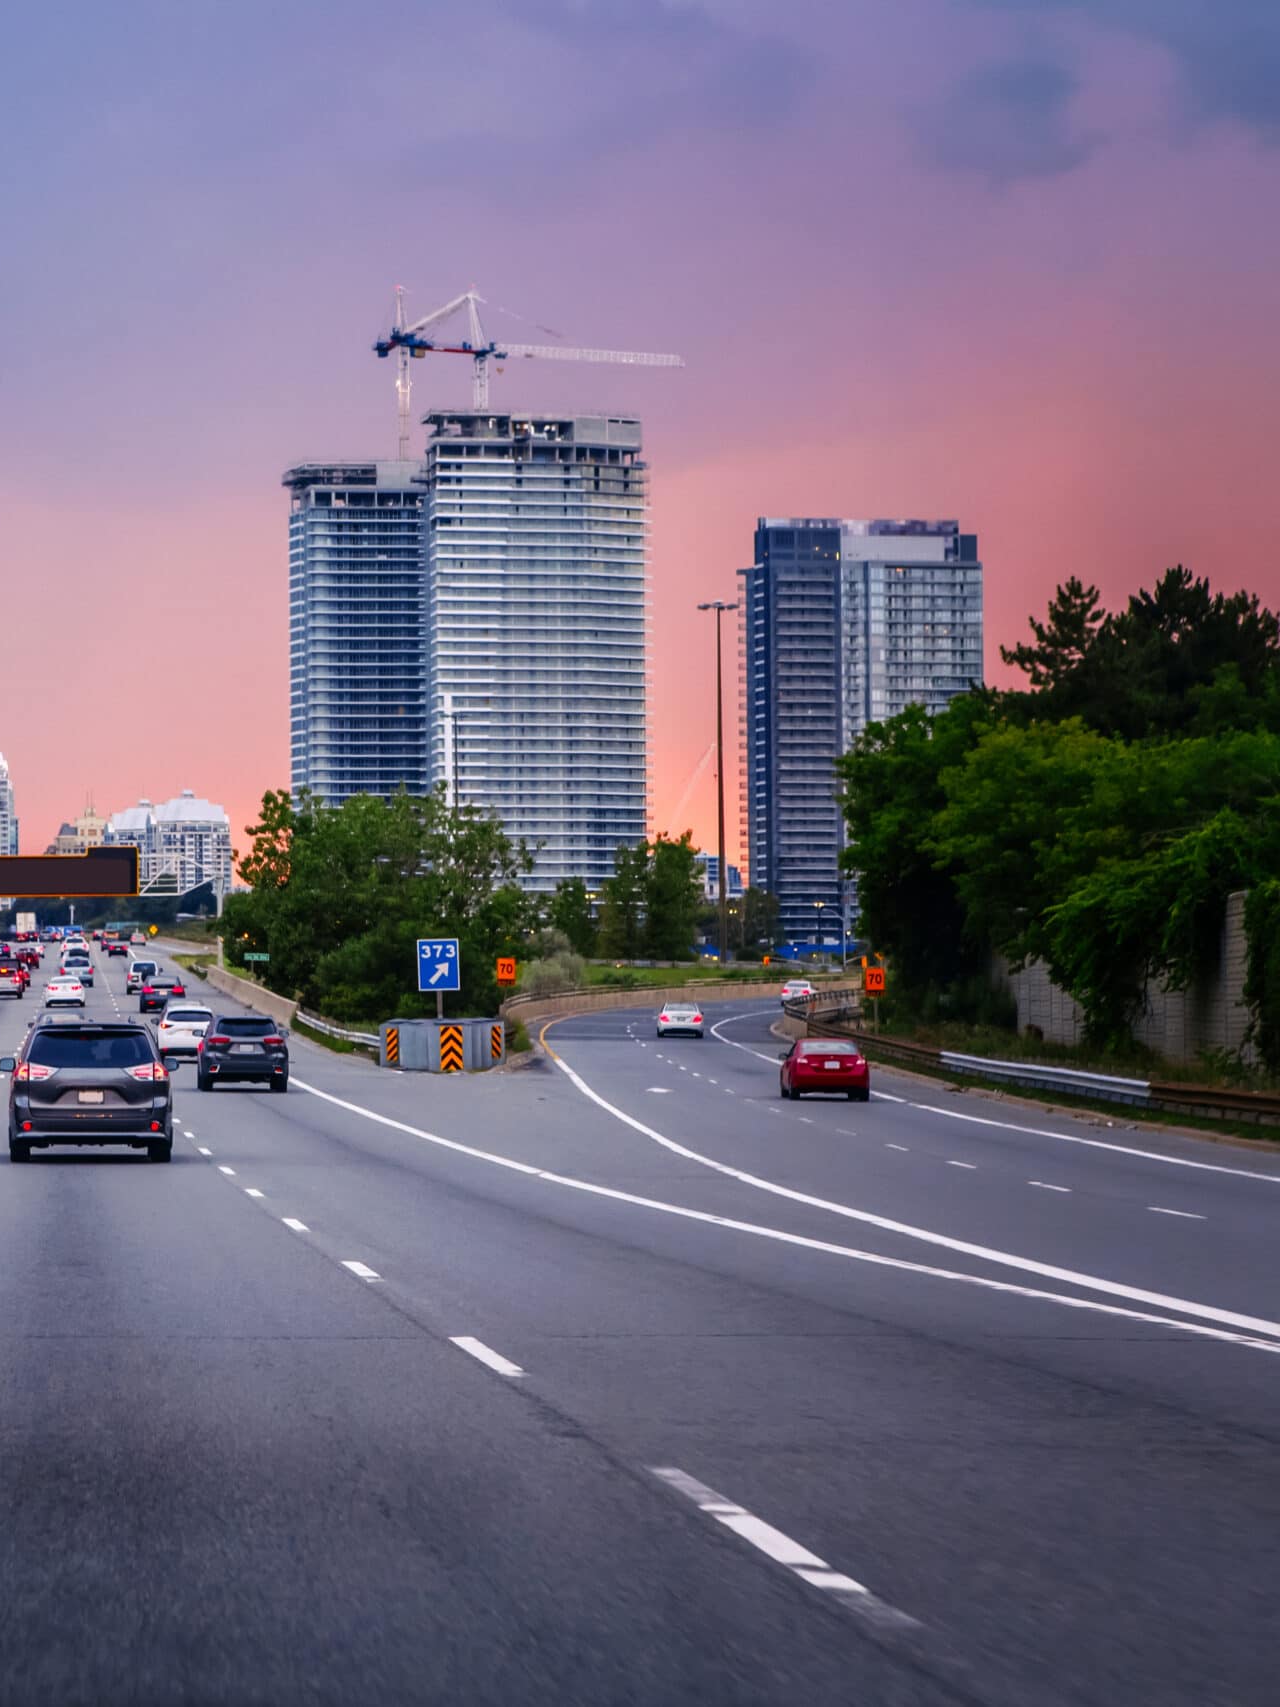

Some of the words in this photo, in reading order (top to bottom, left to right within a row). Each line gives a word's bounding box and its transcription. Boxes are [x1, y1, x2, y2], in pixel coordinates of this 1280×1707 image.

[421, 944, 455, 959] 373
[500, 963, 513, 974] 70
[869, 973, 882, 985] 70
